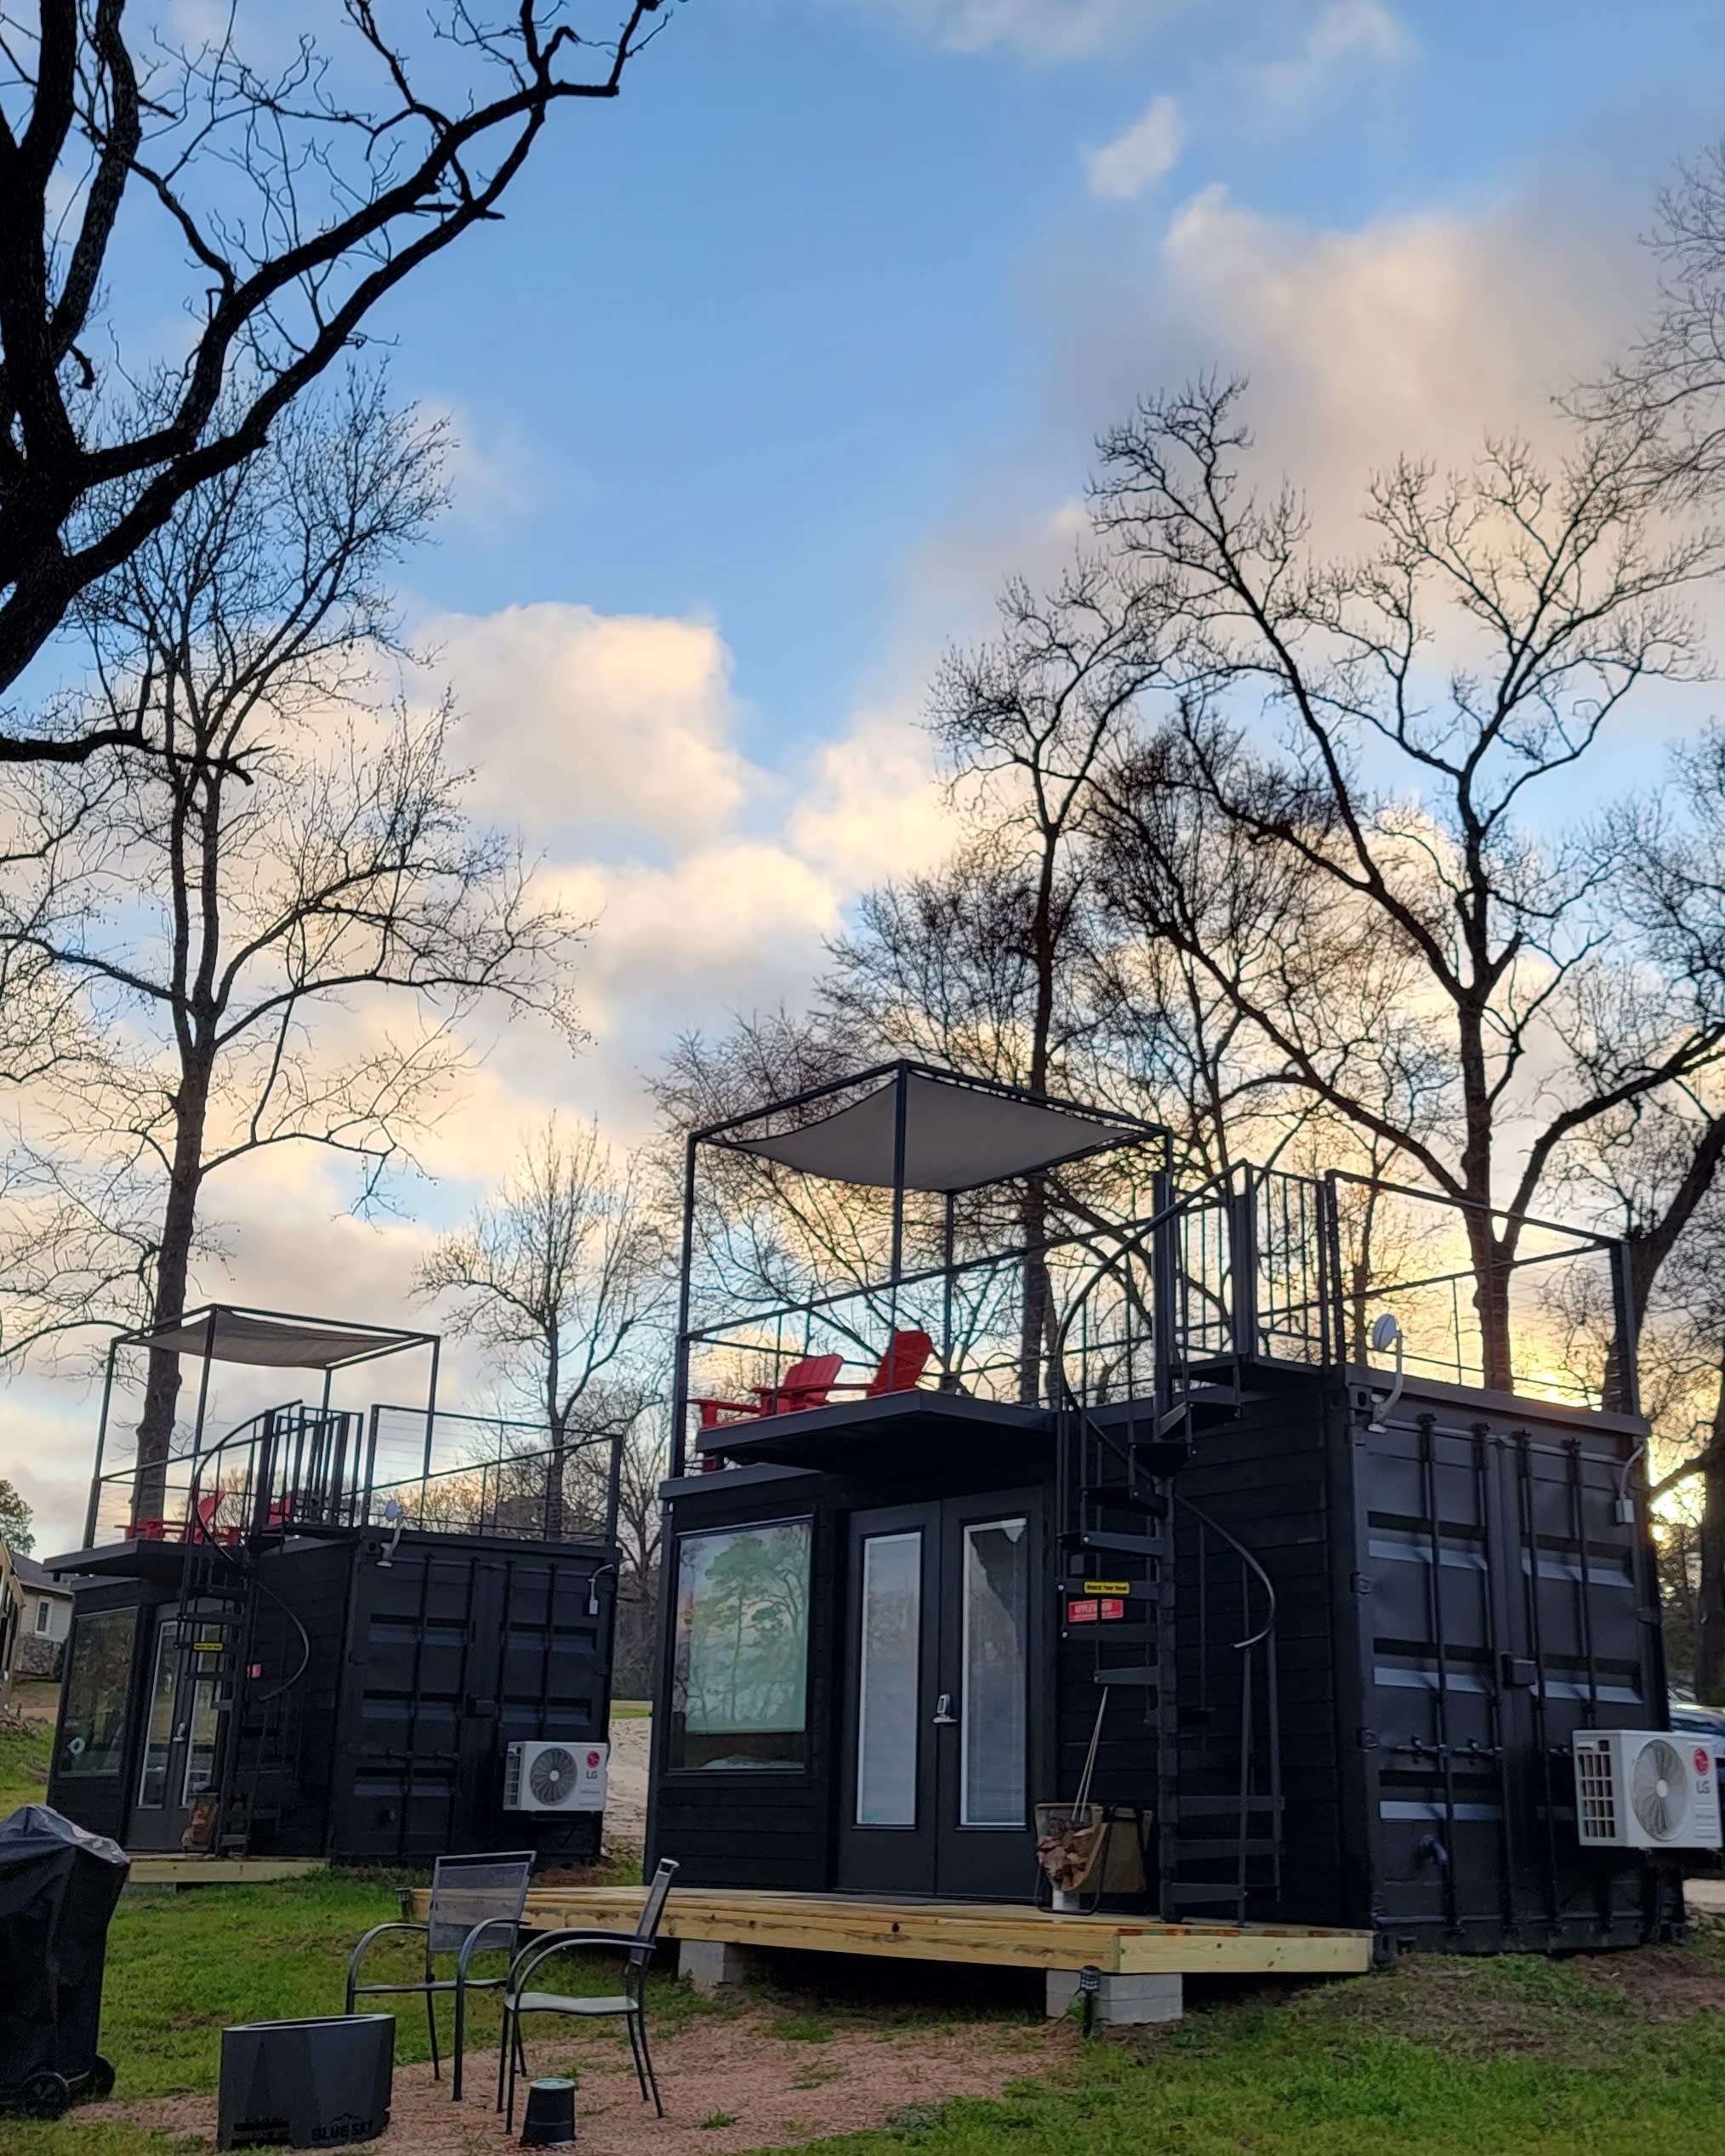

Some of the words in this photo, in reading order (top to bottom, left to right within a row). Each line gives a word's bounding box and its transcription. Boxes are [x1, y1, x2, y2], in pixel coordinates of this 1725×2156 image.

[585, 1770, 598, 1779] LG
[1696, 1780, 1711, 1795] LG
[311, 2125, 348, 2141] BLUE
[350, 2120, 373, 2136] SKY
